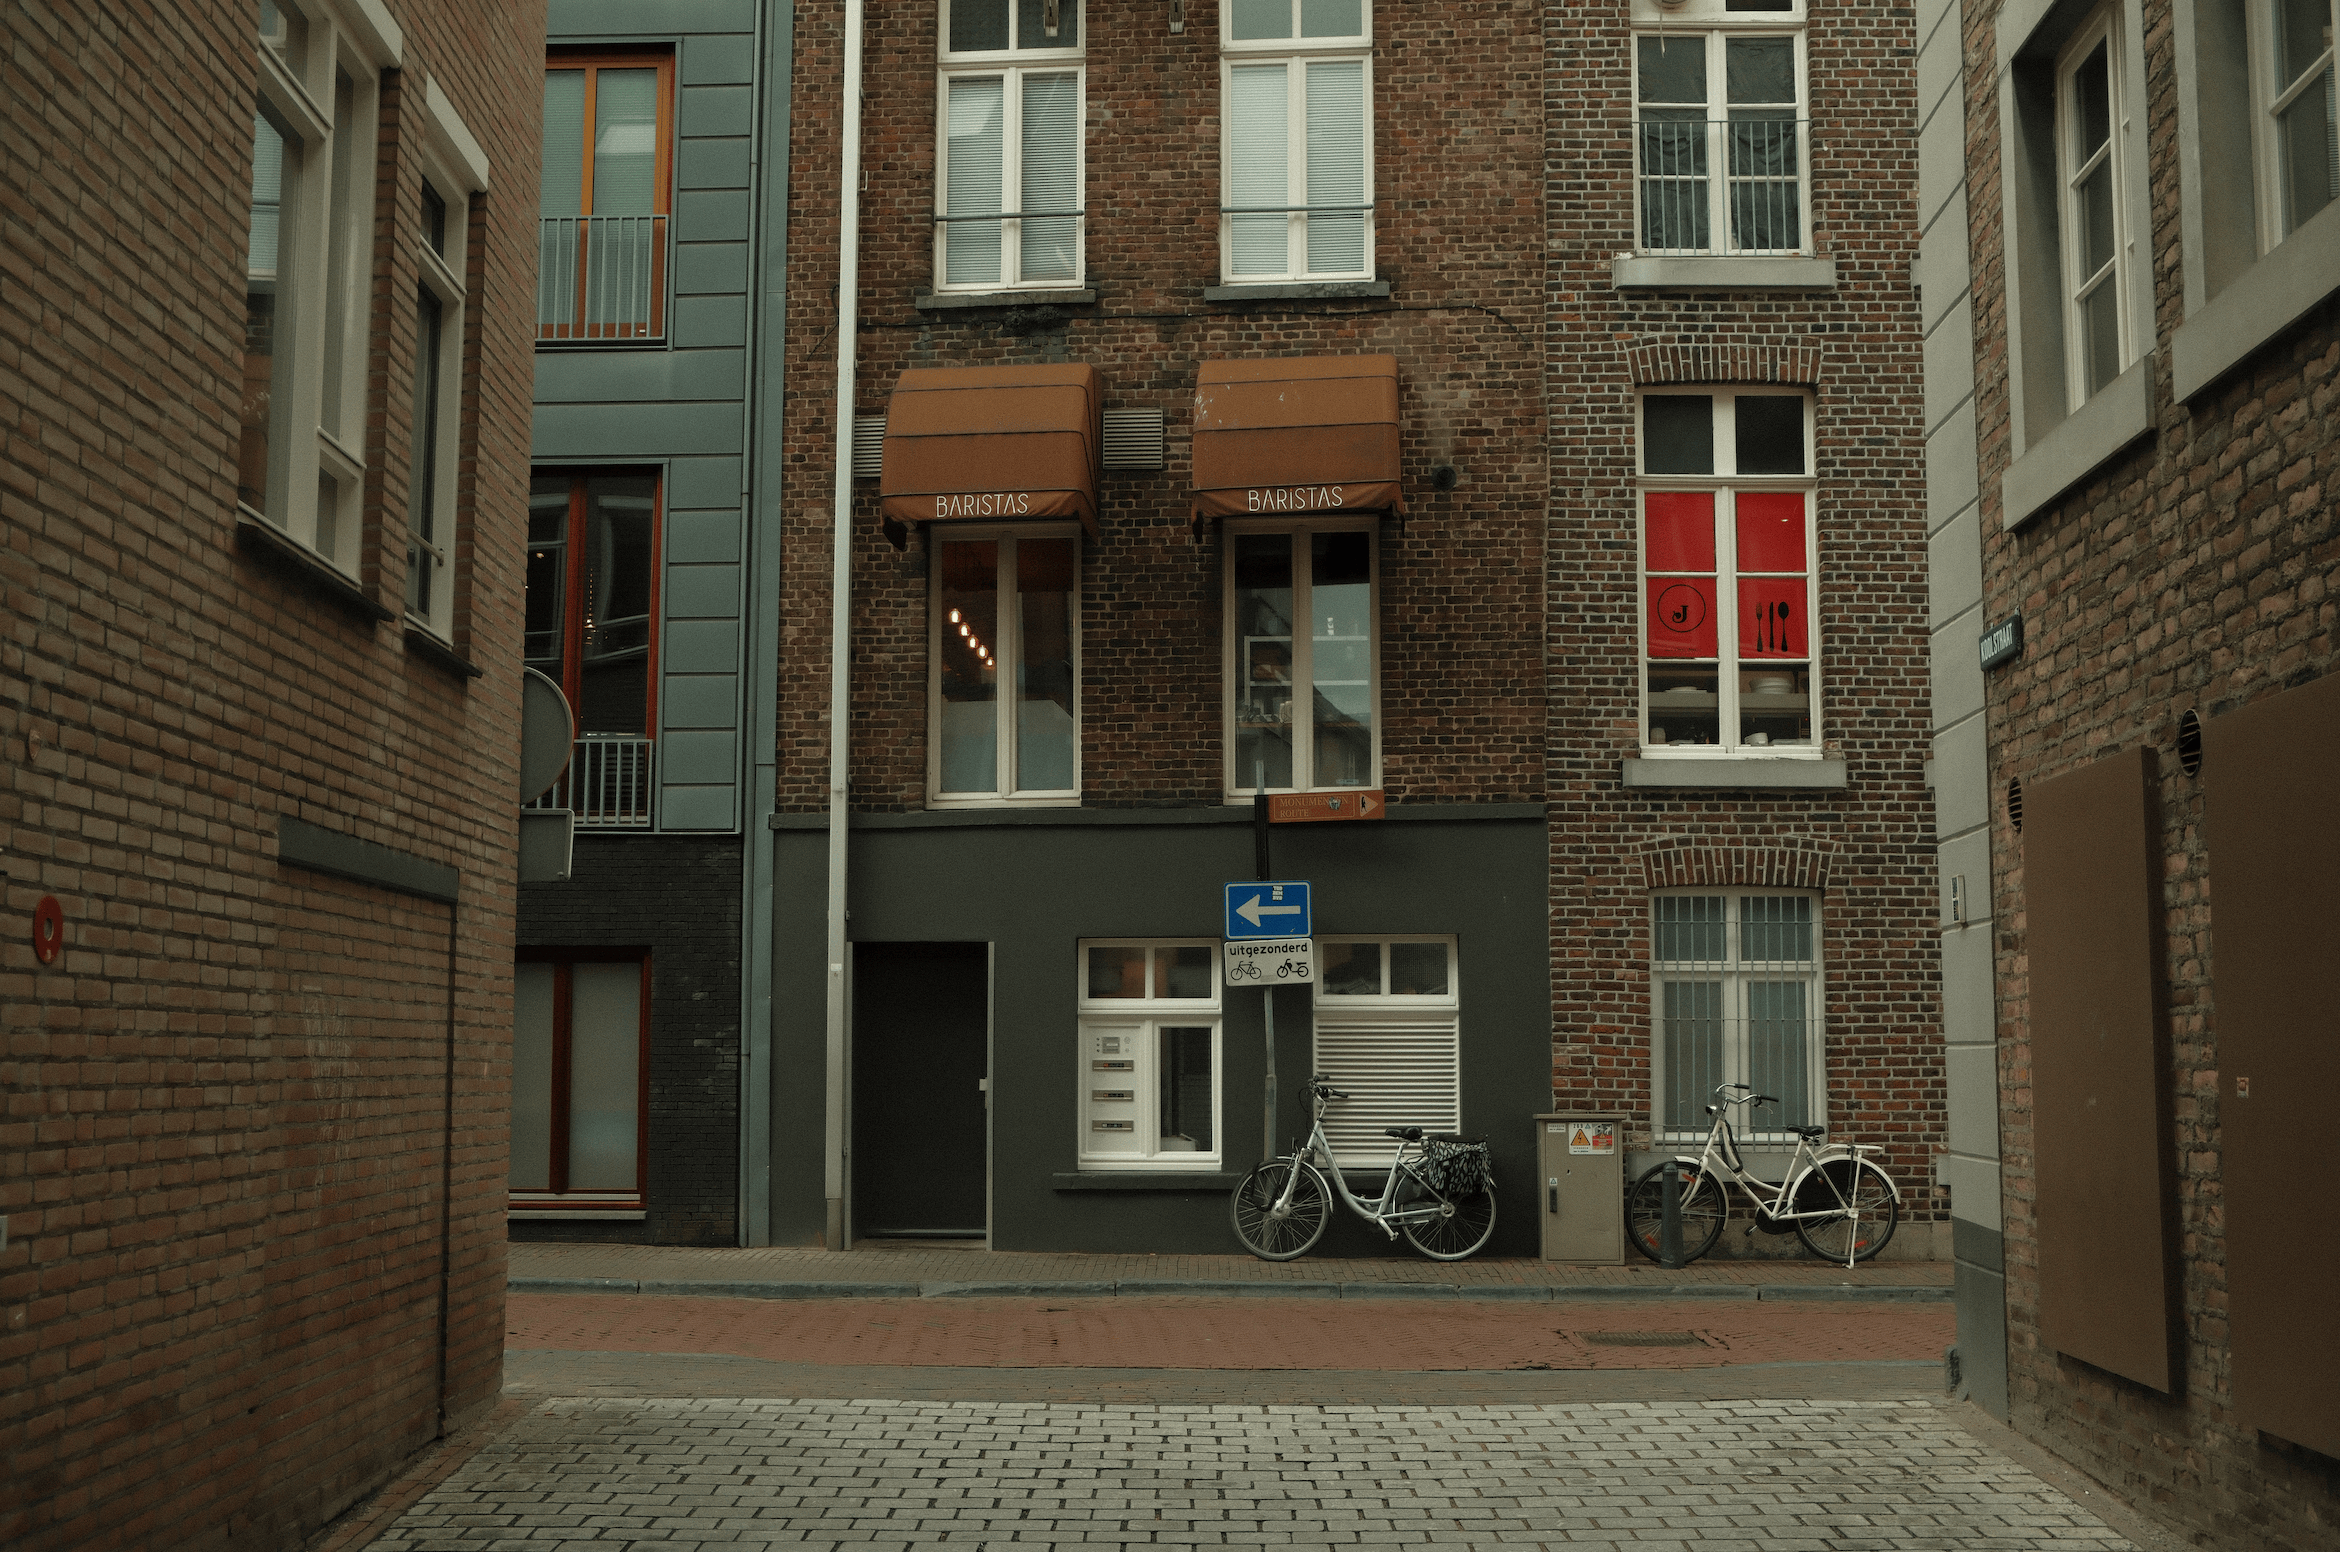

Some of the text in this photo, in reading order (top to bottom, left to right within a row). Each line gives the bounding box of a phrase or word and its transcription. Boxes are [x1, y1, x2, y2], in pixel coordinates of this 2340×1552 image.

[1672, 605, 1689, 624] J
[1280, 796, 1348, 807] MONUMENN
[1280, 808, 1309, 818] ROUTE
[1229, 942, 1308, 958] uitgezonderd
